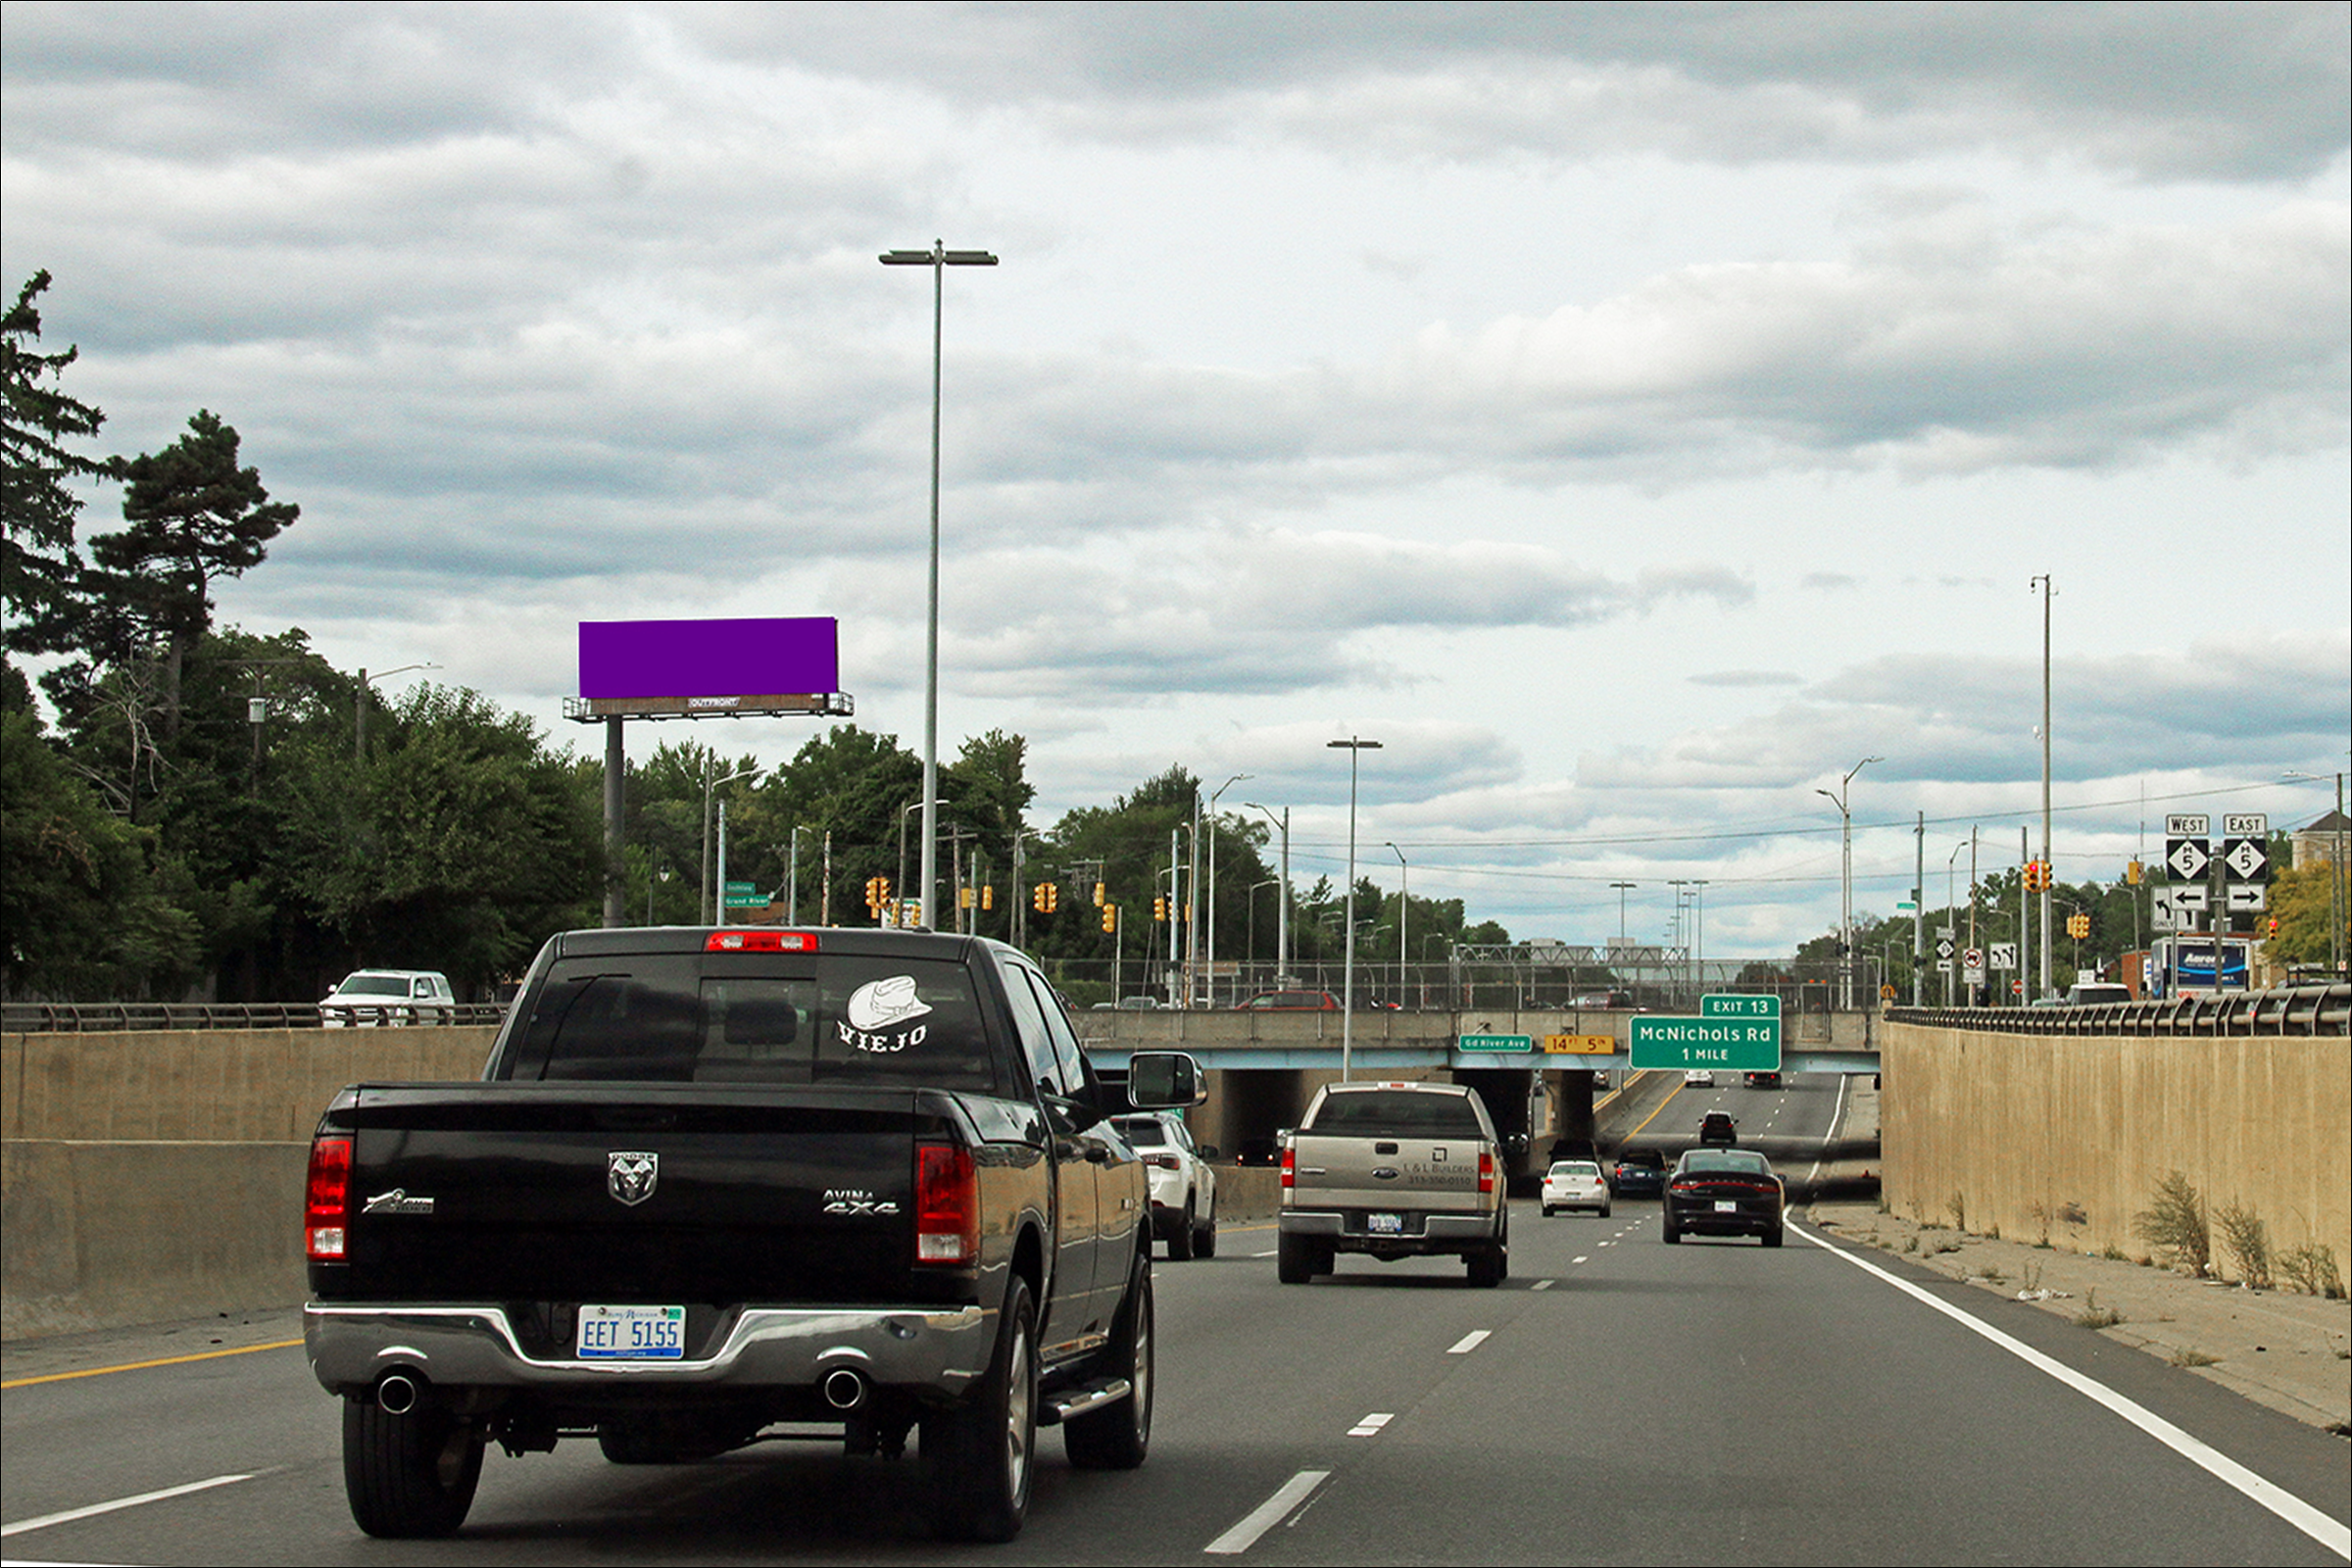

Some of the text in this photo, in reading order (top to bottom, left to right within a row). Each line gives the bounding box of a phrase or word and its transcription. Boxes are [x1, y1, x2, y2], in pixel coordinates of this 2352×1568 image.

[2171, 818, 2204, 831] WEST
[2230, 817, 2260, 831] EAST
[2182, 855, 2194, 870] 5
[2240, 855, 2252, 870] 5
[1713, 1001, 1769, 1013] EXIT 13
[837, 1019, 927, 1053] VIEJO
[1640, 1026, 1771, 1042] McNichols Rd
[1480, 1039, 1504, 1048] River
[1508, 1039, 1526, 1048] Ave
[1683, 1048, 1728, 1061] 1 MILE
[1412, 1163, 1421, 1173] &
[584, 1321, 678, 1347] EET 5155
